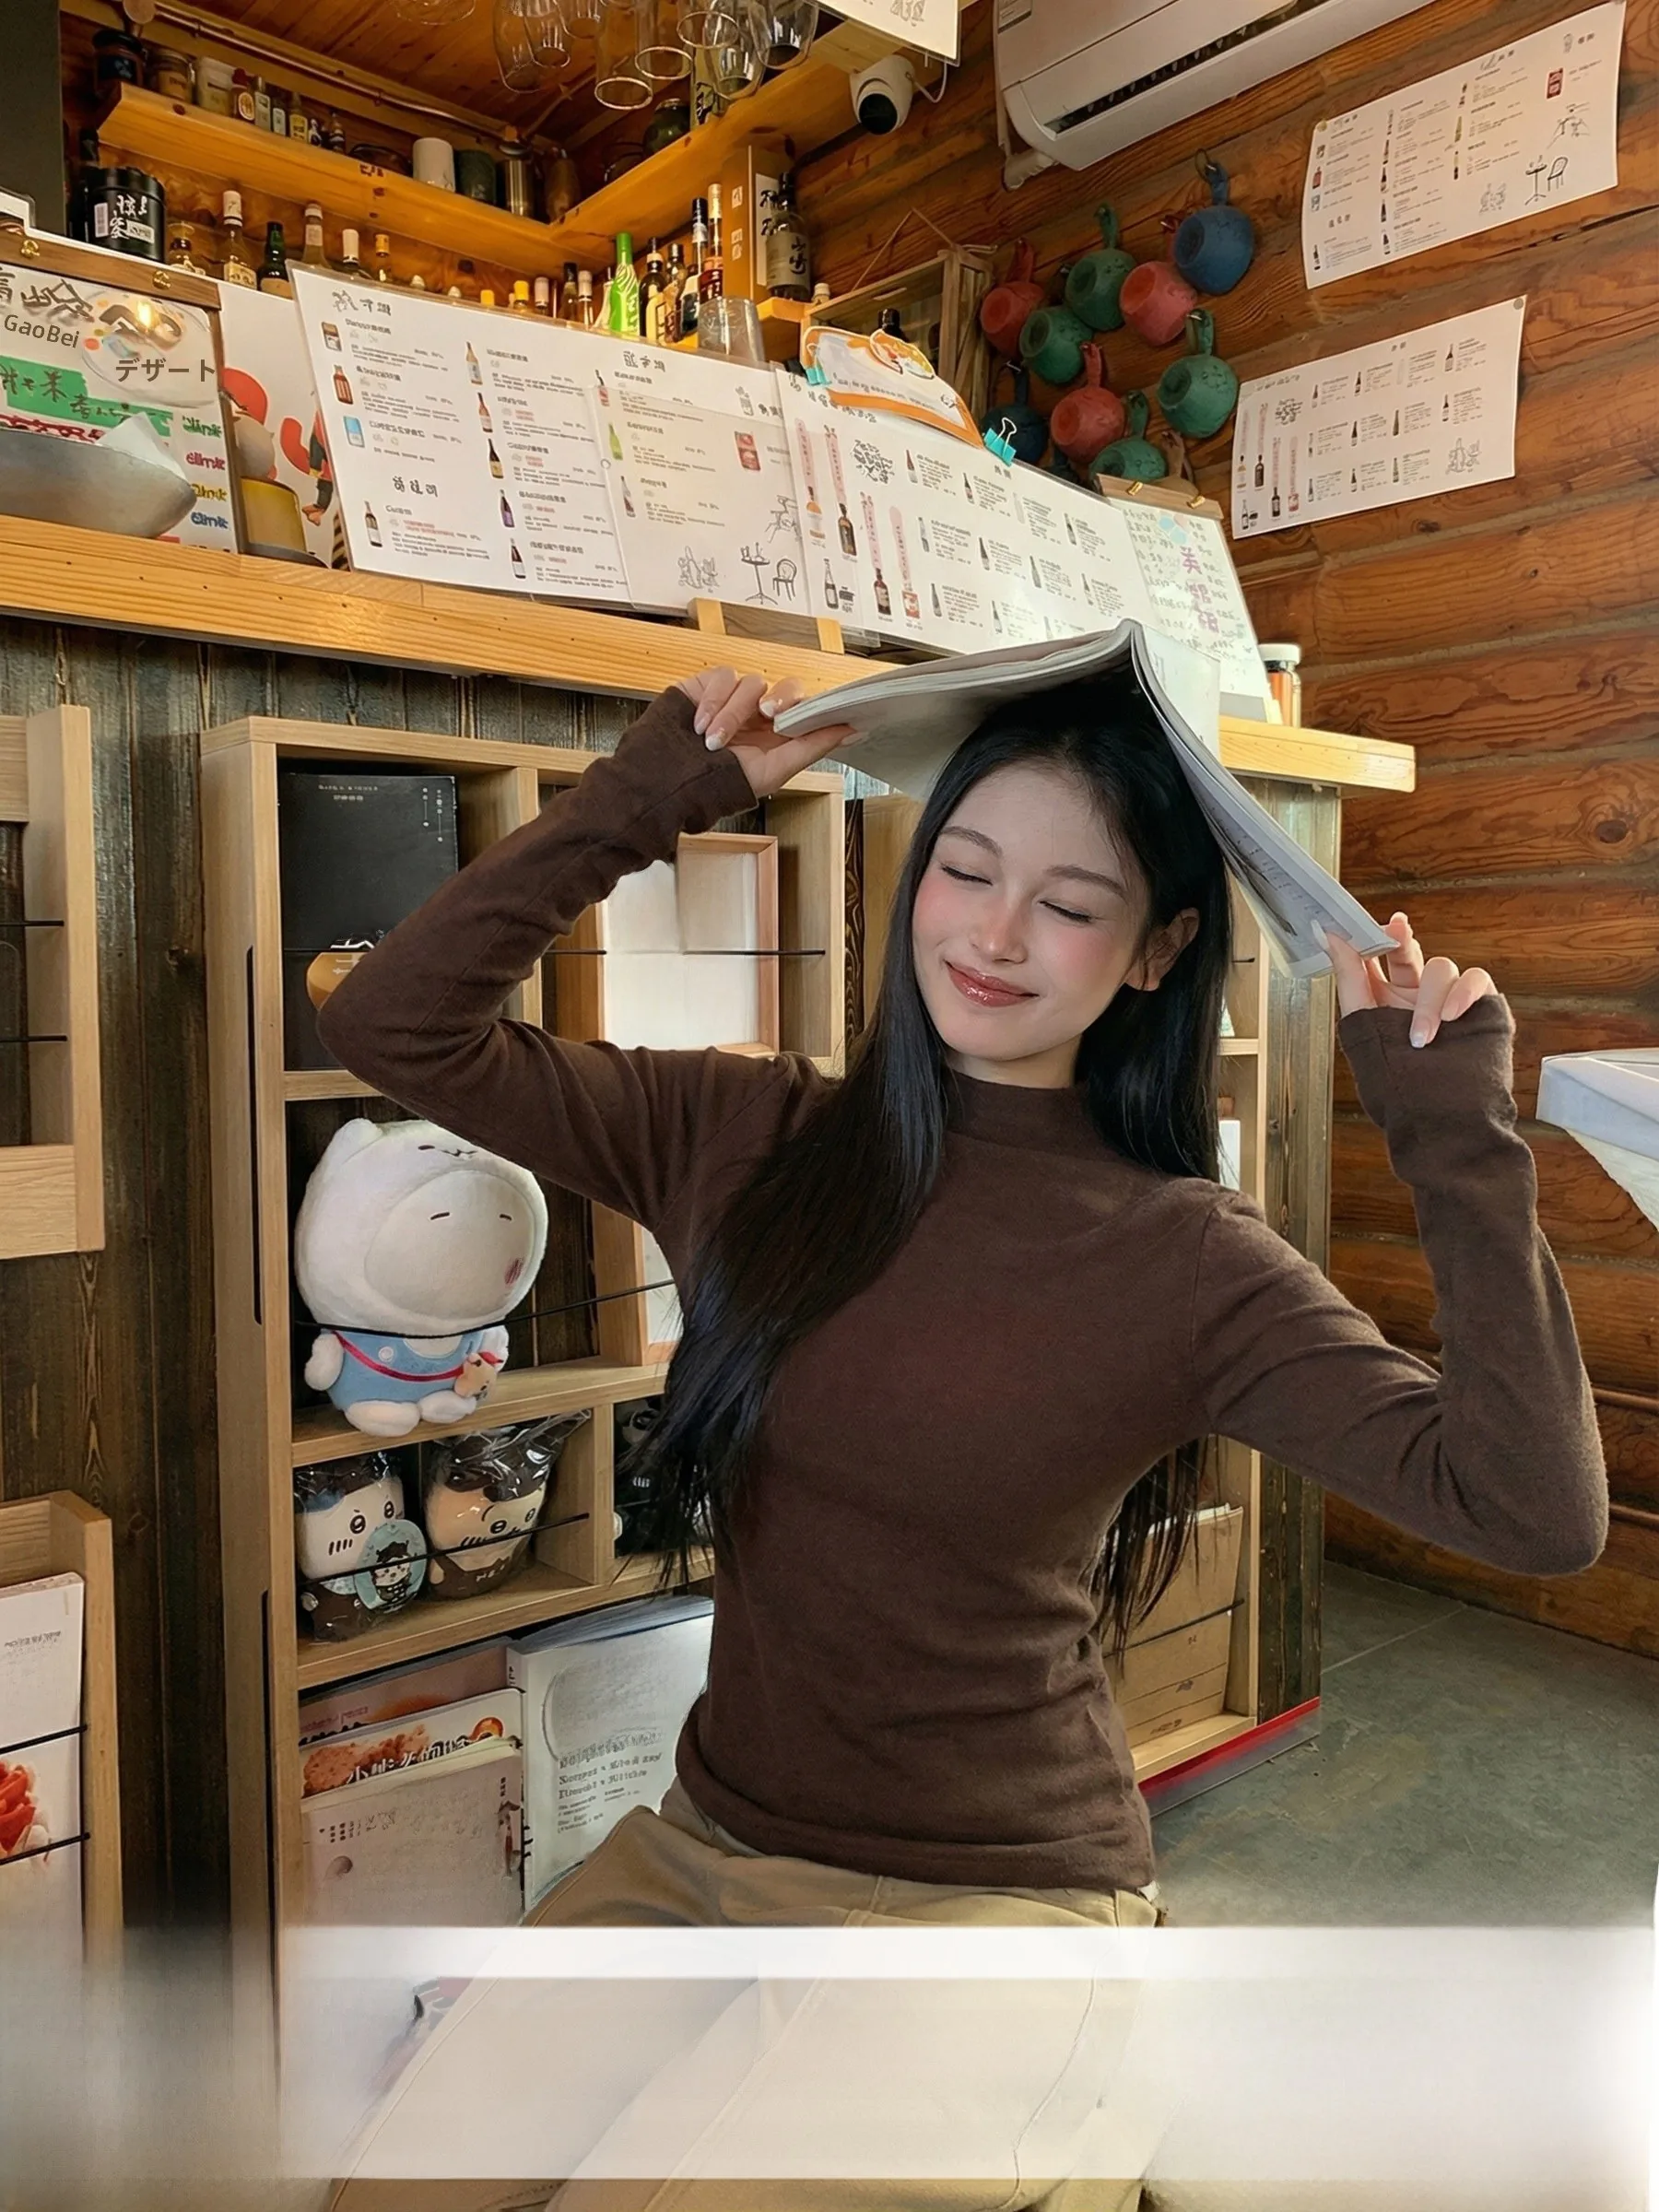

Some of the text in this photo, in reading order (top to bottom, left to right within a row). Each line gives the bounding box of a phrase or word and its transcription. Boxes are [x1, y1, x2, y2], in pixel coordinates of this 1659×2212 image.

[4, 314, 80, 348] GaoBei
[115, 358, 216, 382] デザート
